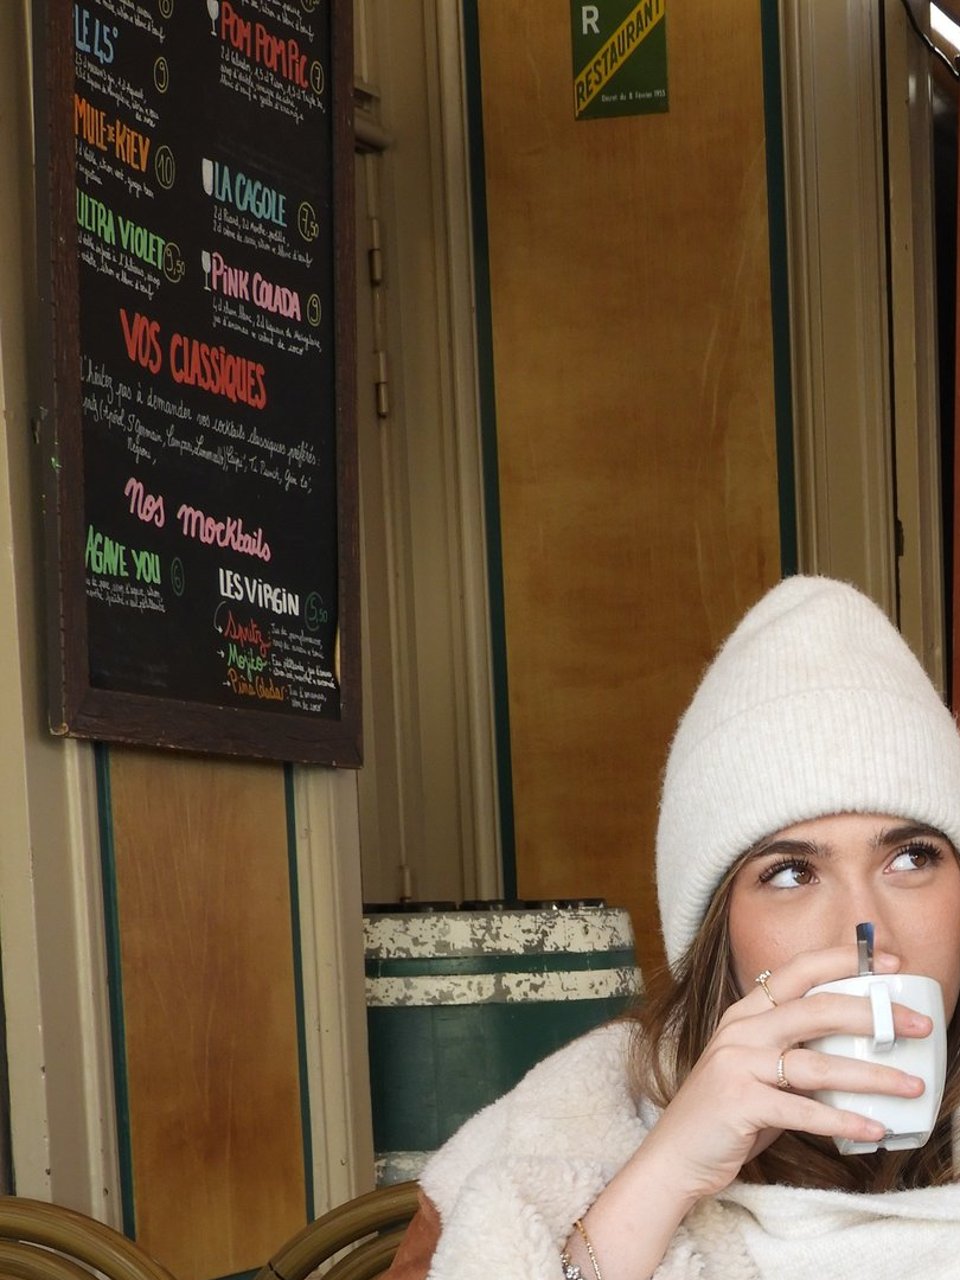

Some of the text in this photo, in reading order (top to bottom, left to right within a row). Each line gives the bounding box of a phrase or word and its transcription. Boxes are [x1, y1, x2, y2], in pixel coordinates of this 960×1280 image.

[75, 3, 91, 53] LE
[94, 18, 119, 65] 45°
[221, 0, 251, 58] POM
[255, 21, 287, 79] POM
[582, 5, 600, 35] R
[74, 93, 108, 151] MULE
[158, 154, 173, 185] 10
[214, 161, 288, 228] LA CAGOLE
[76, 187, 116, 246] ULTRA
[252, 271, 302, 322] COLADA
[120, 307, 163, 375] VOS
[116, 382, 133, 408] pas
[136, 381, 144, 405] à
[147, 387, 193, 421] demander
[196, 413, 211, 429] vos
[212, 418, 246, 441] cocktails
[247, 426, 286, 460] classiques
[85, 524, 162, 585] AGAVE YOU
[219, 567, 244, 602] LES
[227, 643, 267, 683] Mojito
